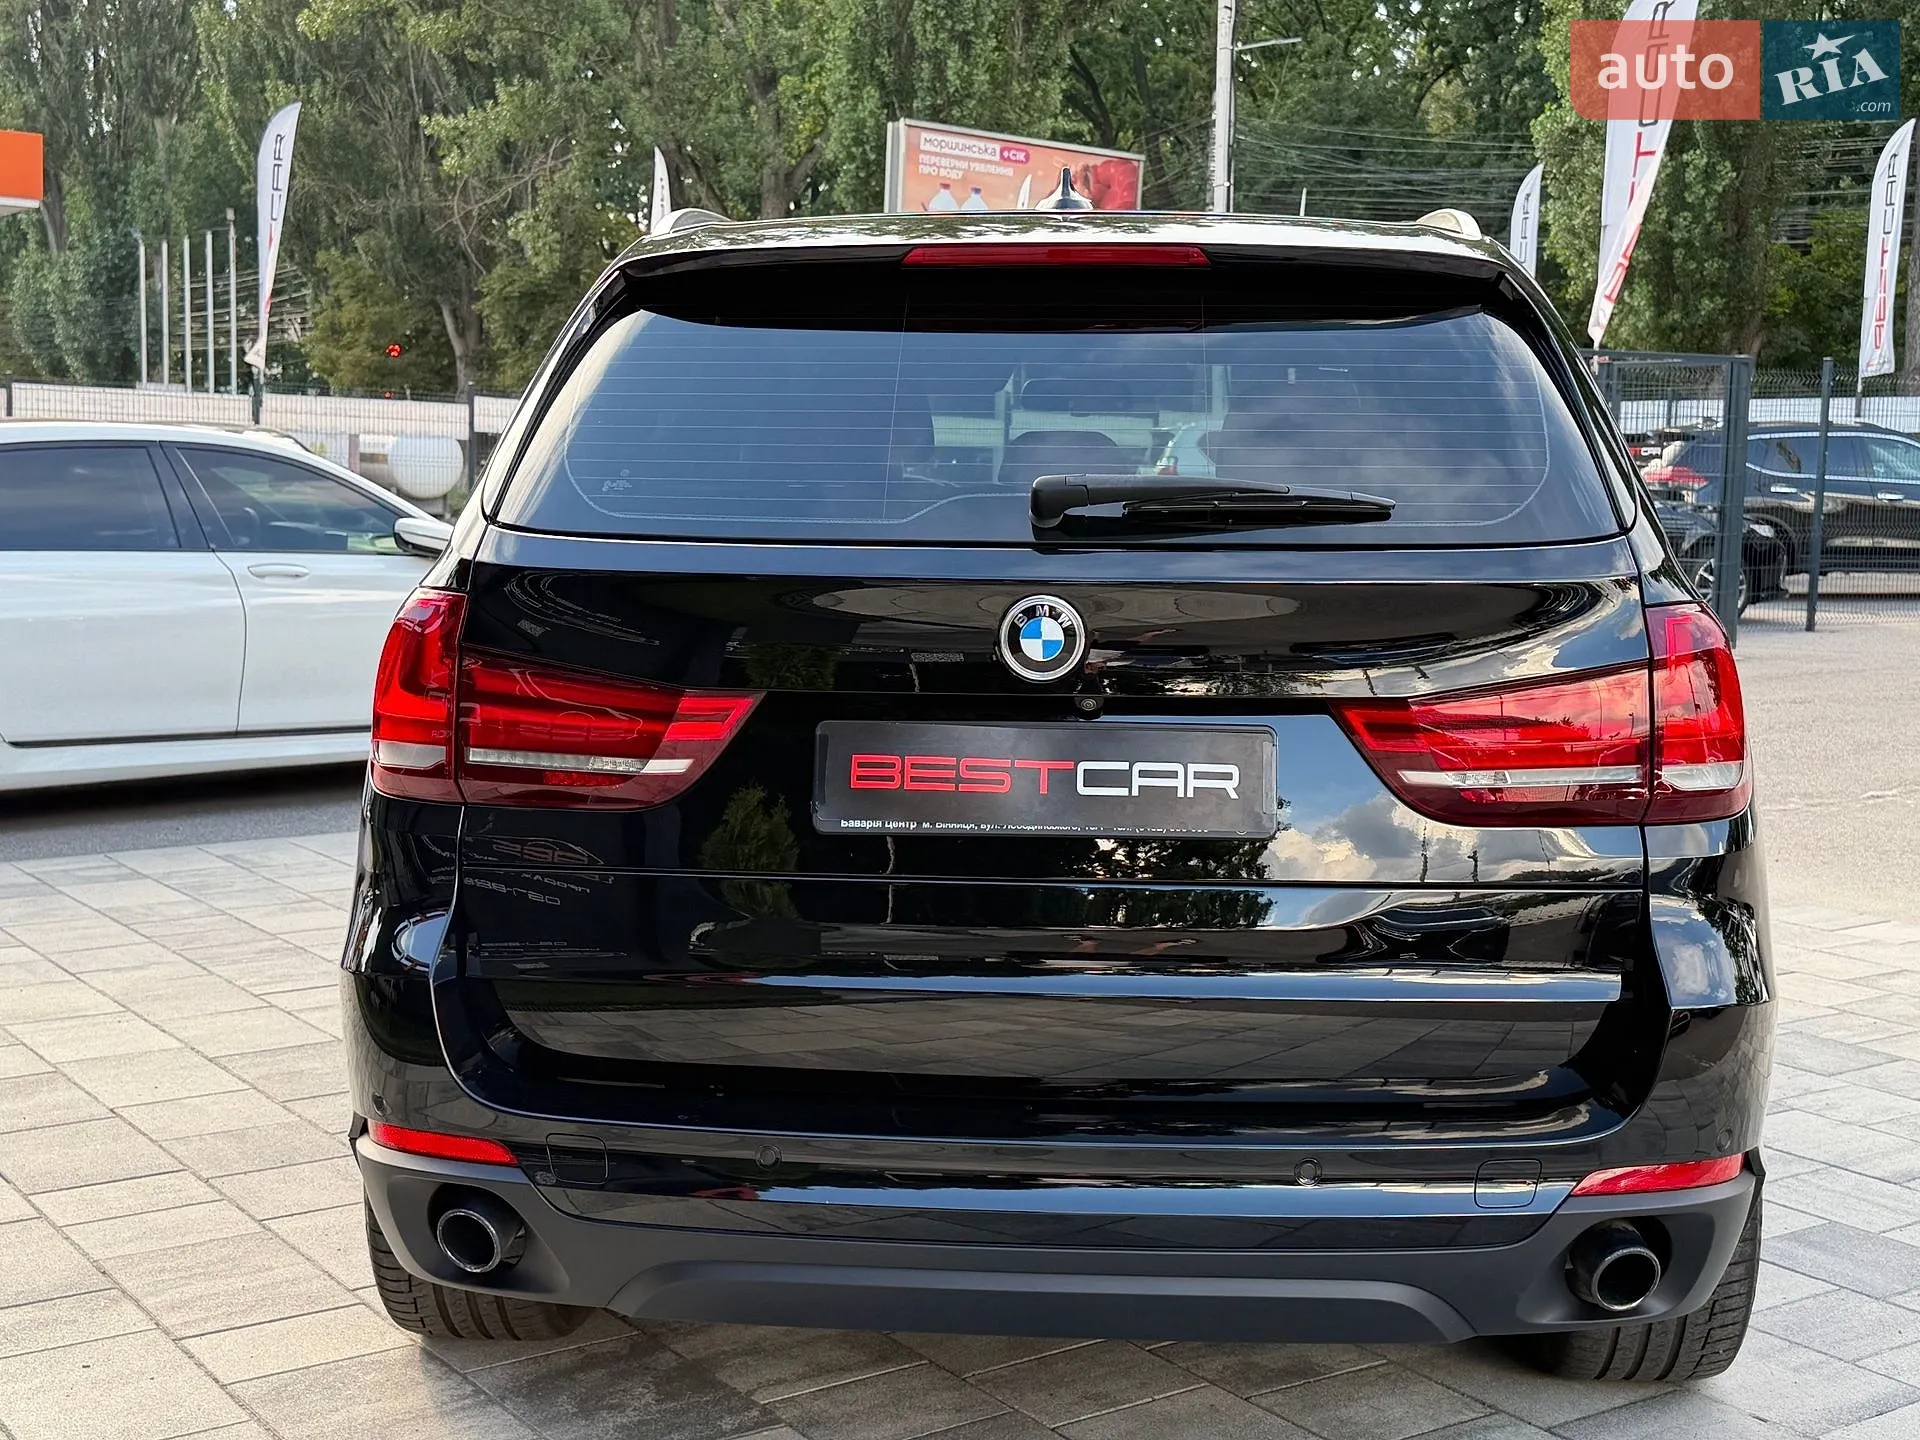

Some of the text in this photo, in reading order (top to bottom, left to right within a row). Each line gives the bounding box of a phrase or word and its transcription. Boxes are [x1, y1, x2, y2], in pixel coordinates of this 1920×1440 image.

[923, 136, 998, 157] моршинська
[919, 165, 964, 180] ПРО ВОДУ
[1014, 605, 1073, 628] BMW
[849, 753, 1241, 800] BESTCAR
